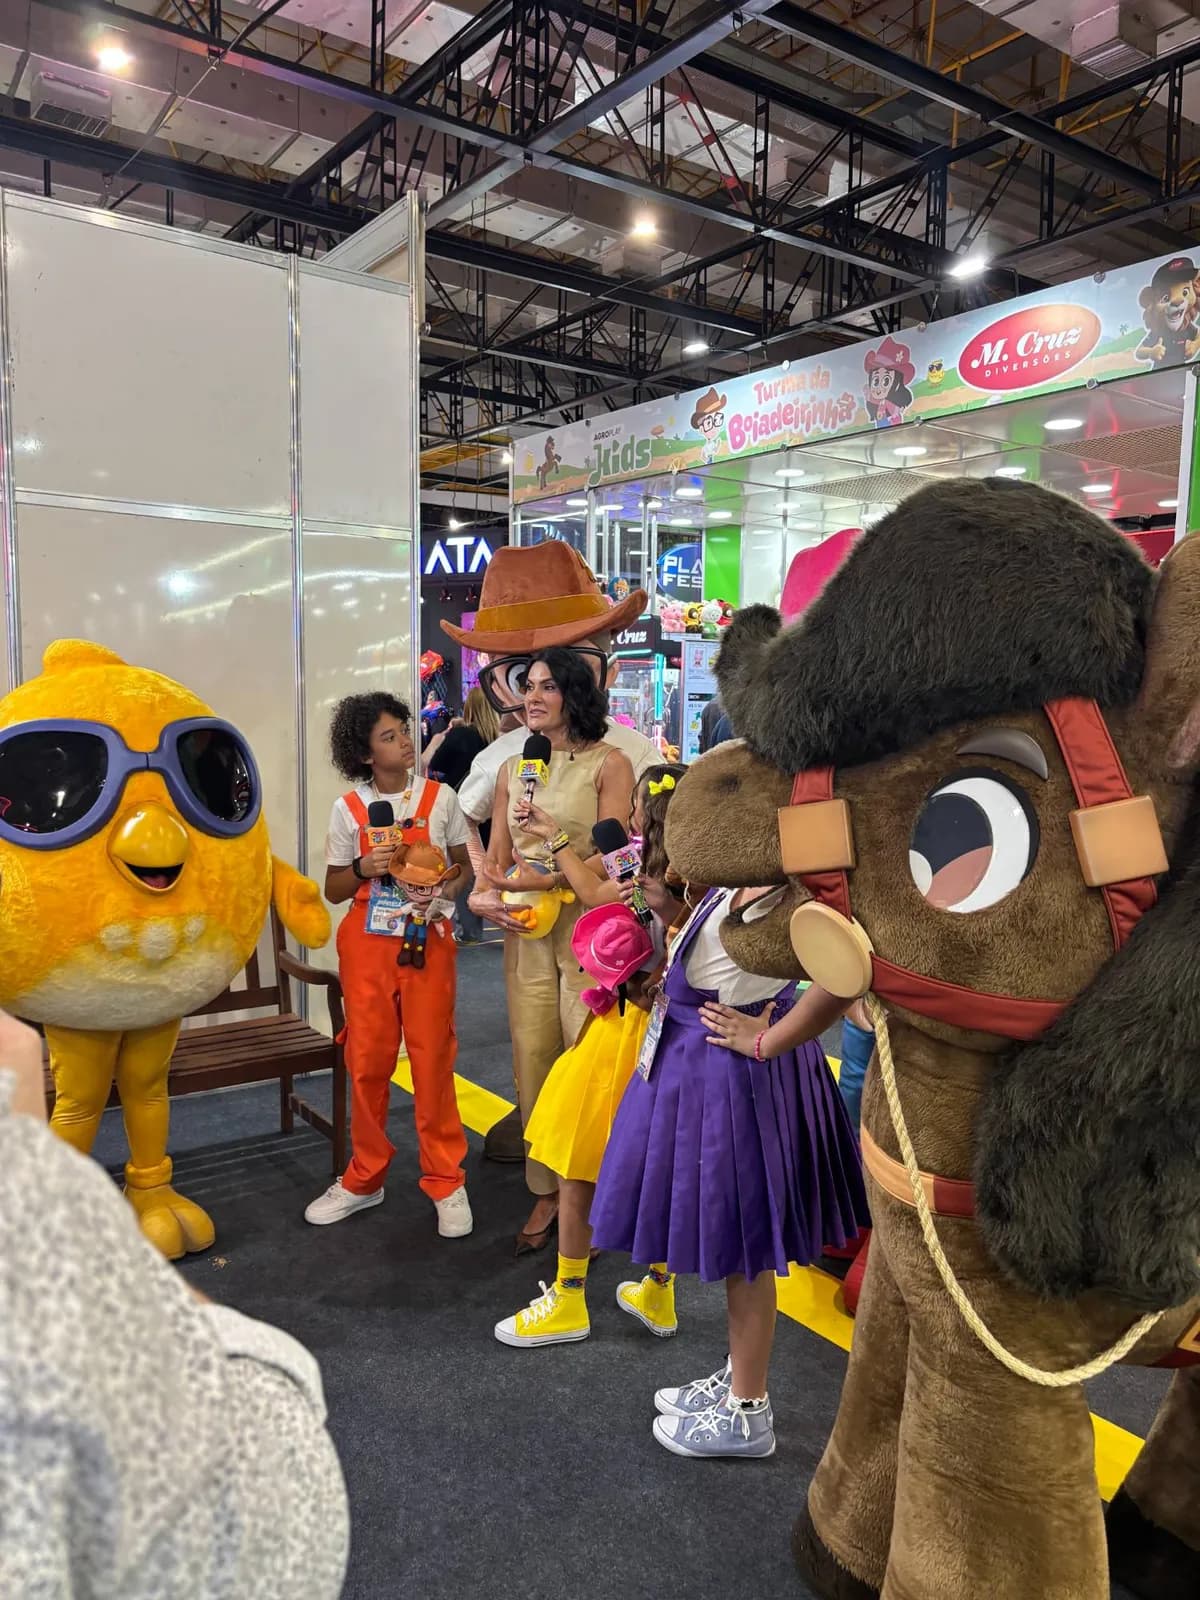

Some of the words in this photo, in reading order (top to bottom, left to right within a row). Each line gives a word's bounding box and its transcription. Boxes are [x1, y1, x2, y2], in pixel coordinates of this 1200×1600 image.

[970, 338, 1009, 369] M.
[1016, 326, 1082, 357] Cruz
[984, 352, 1072, 378] DIVERSÕES
[753, 372, 807, 405] Turma
[810, 365, 831, 390] da
[593, 426, 622, 441] AGROPLAY
[728, 393, 856, 451] Boiadeirinha
[616, 628, 647, 645] Cruz
